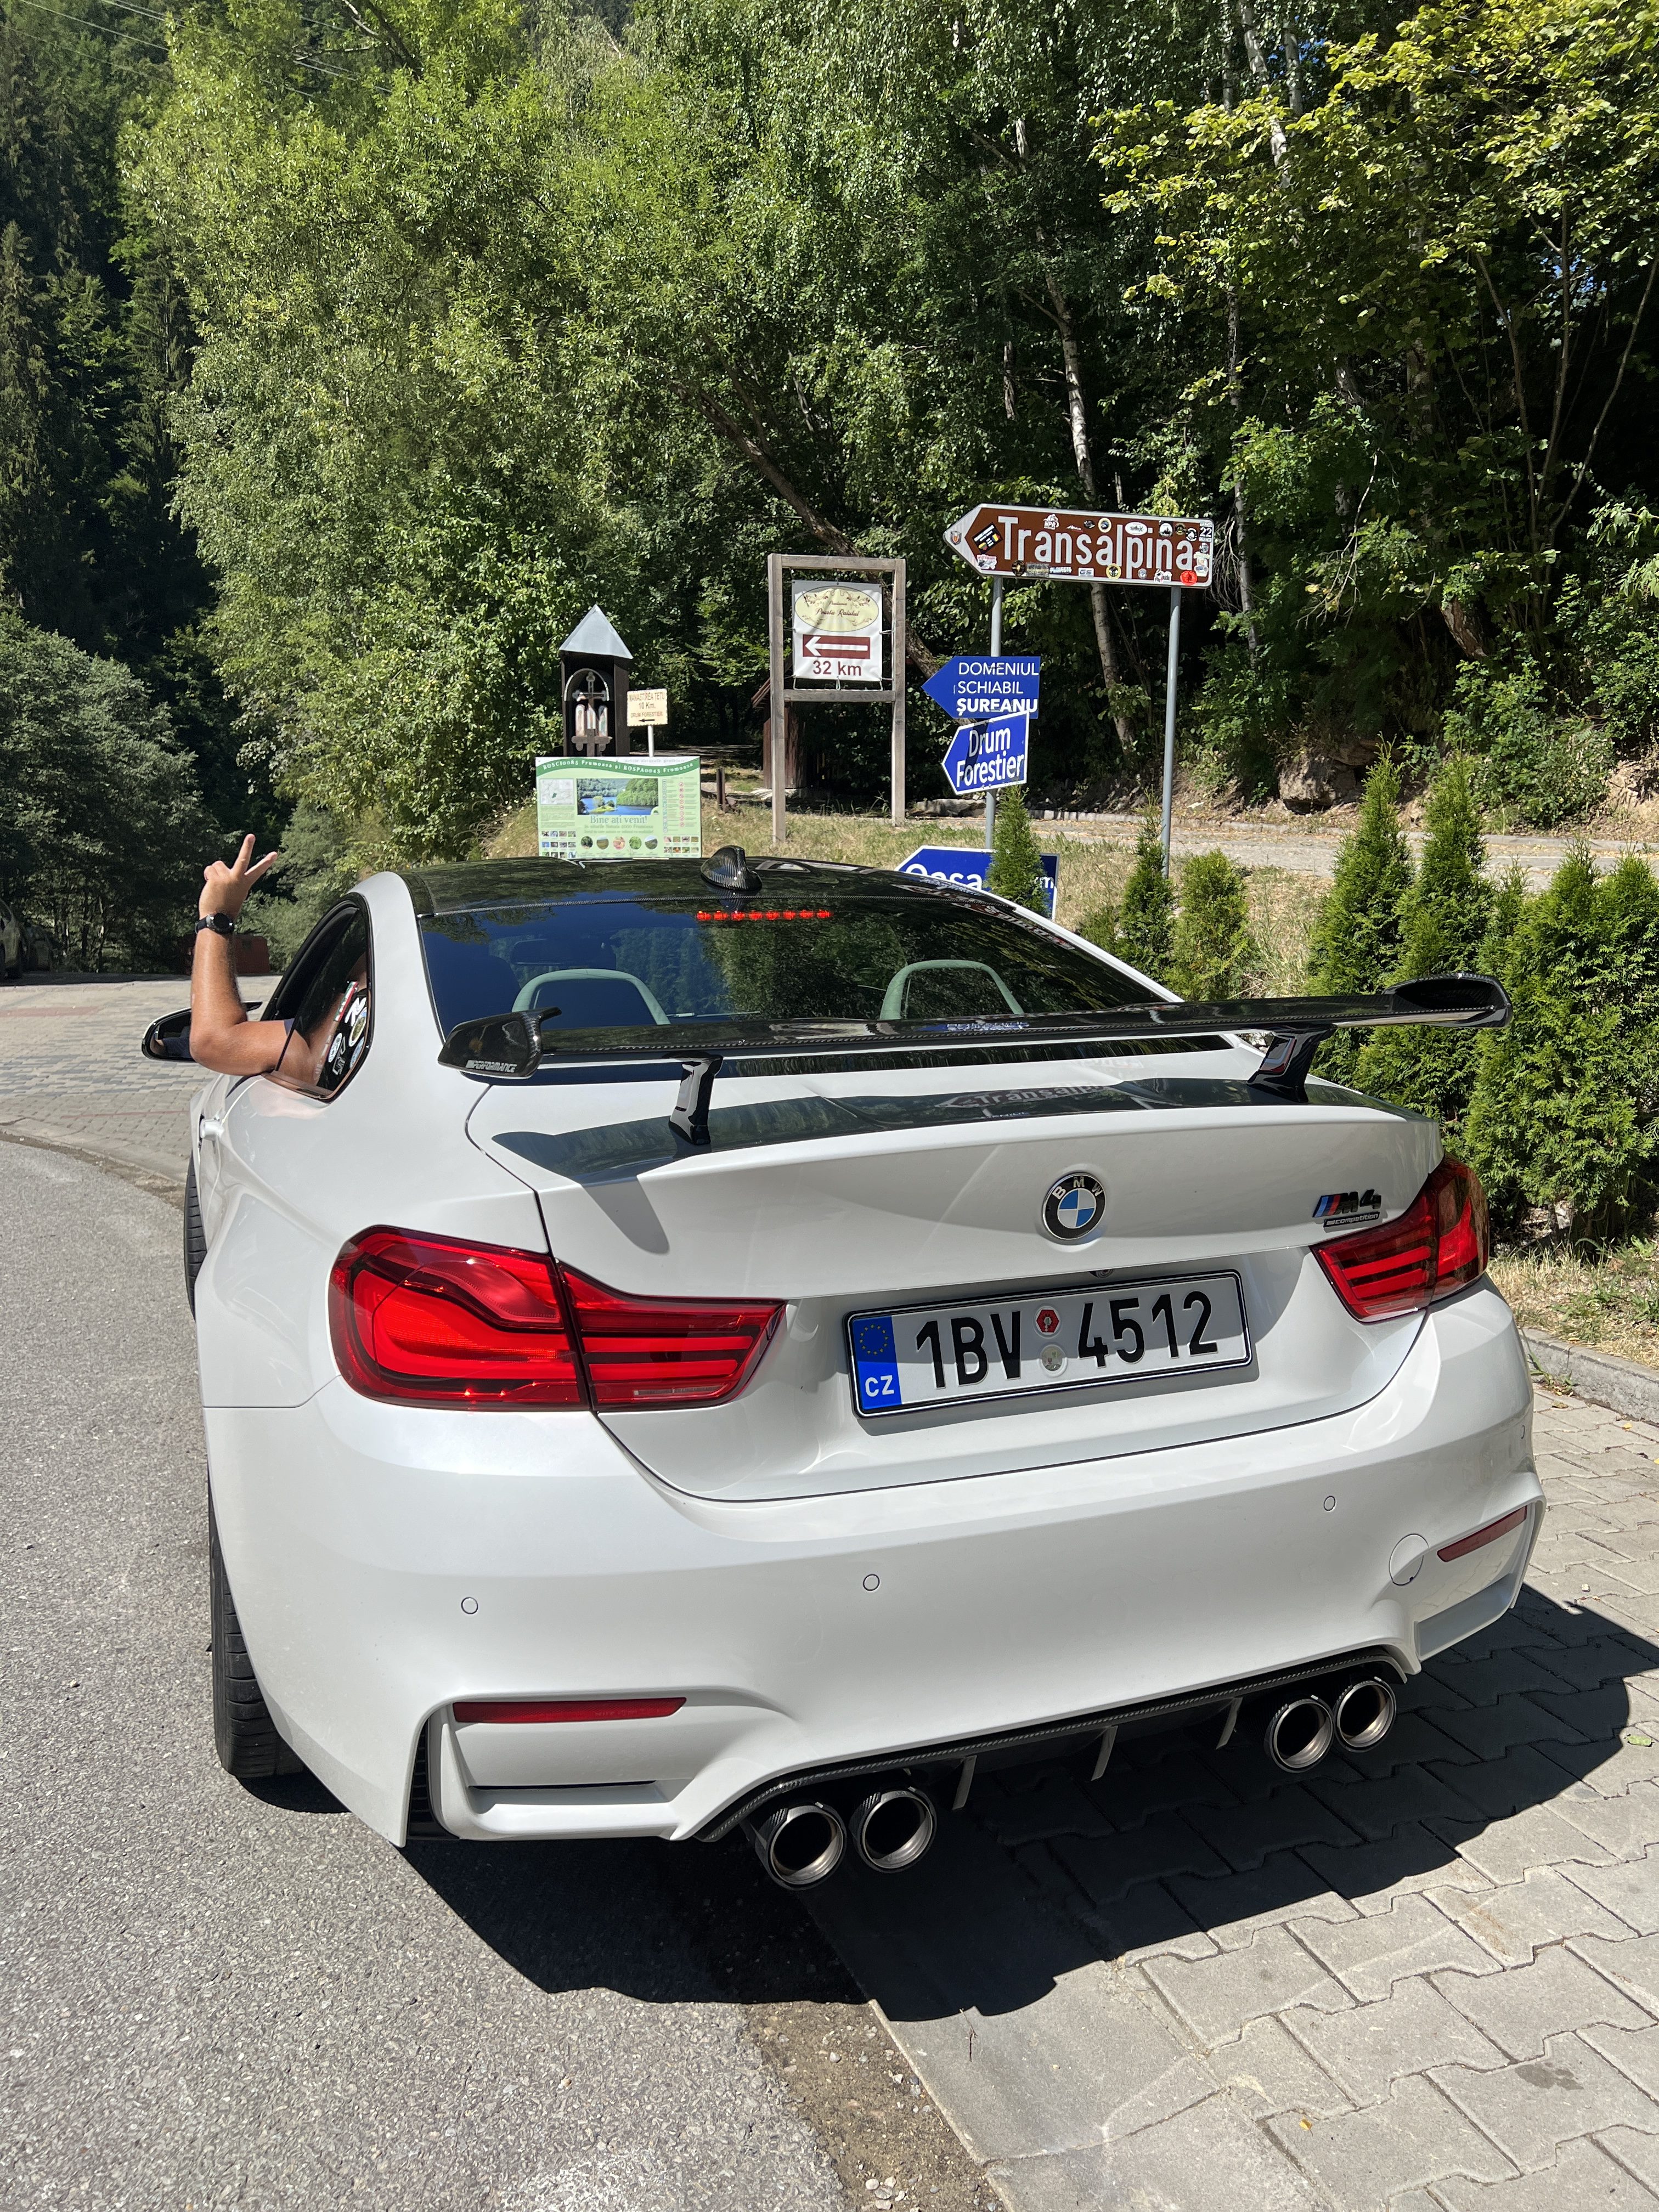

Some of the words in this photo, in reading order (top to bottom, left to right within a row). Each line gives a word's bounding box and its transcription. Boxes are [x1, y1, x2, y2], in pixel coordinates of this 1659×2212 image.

[1200, 527, 1212, 538] 22
[997, 516, 1193, 579] Transalpina
[812, 660, 832, 675] 32
[838, 661, 861, 676] km
[958, 662, 1039, 675] DOMENIUL
[957, 681, 1024, 694] SCHIABIL
[969, 727, 1011, 758] Drum
[957, 752, 1025, 788] Forestier
[590, 815, 609, 823] Bine
[624, 815, 647, 823] venit!
[473, 1060, 517, 1073] PERFORMANCE
[1052, 1176, 1103, 1200] BMW
[1333, 1189, 1381, 1215] M4
[1335, 1212, 1379, 1225] competition
[916, 1310, 1022, 1389] 1BV
[1078, 1290, 1218, 1368] 4512
[865, 1374, 895, 1397] CZ
